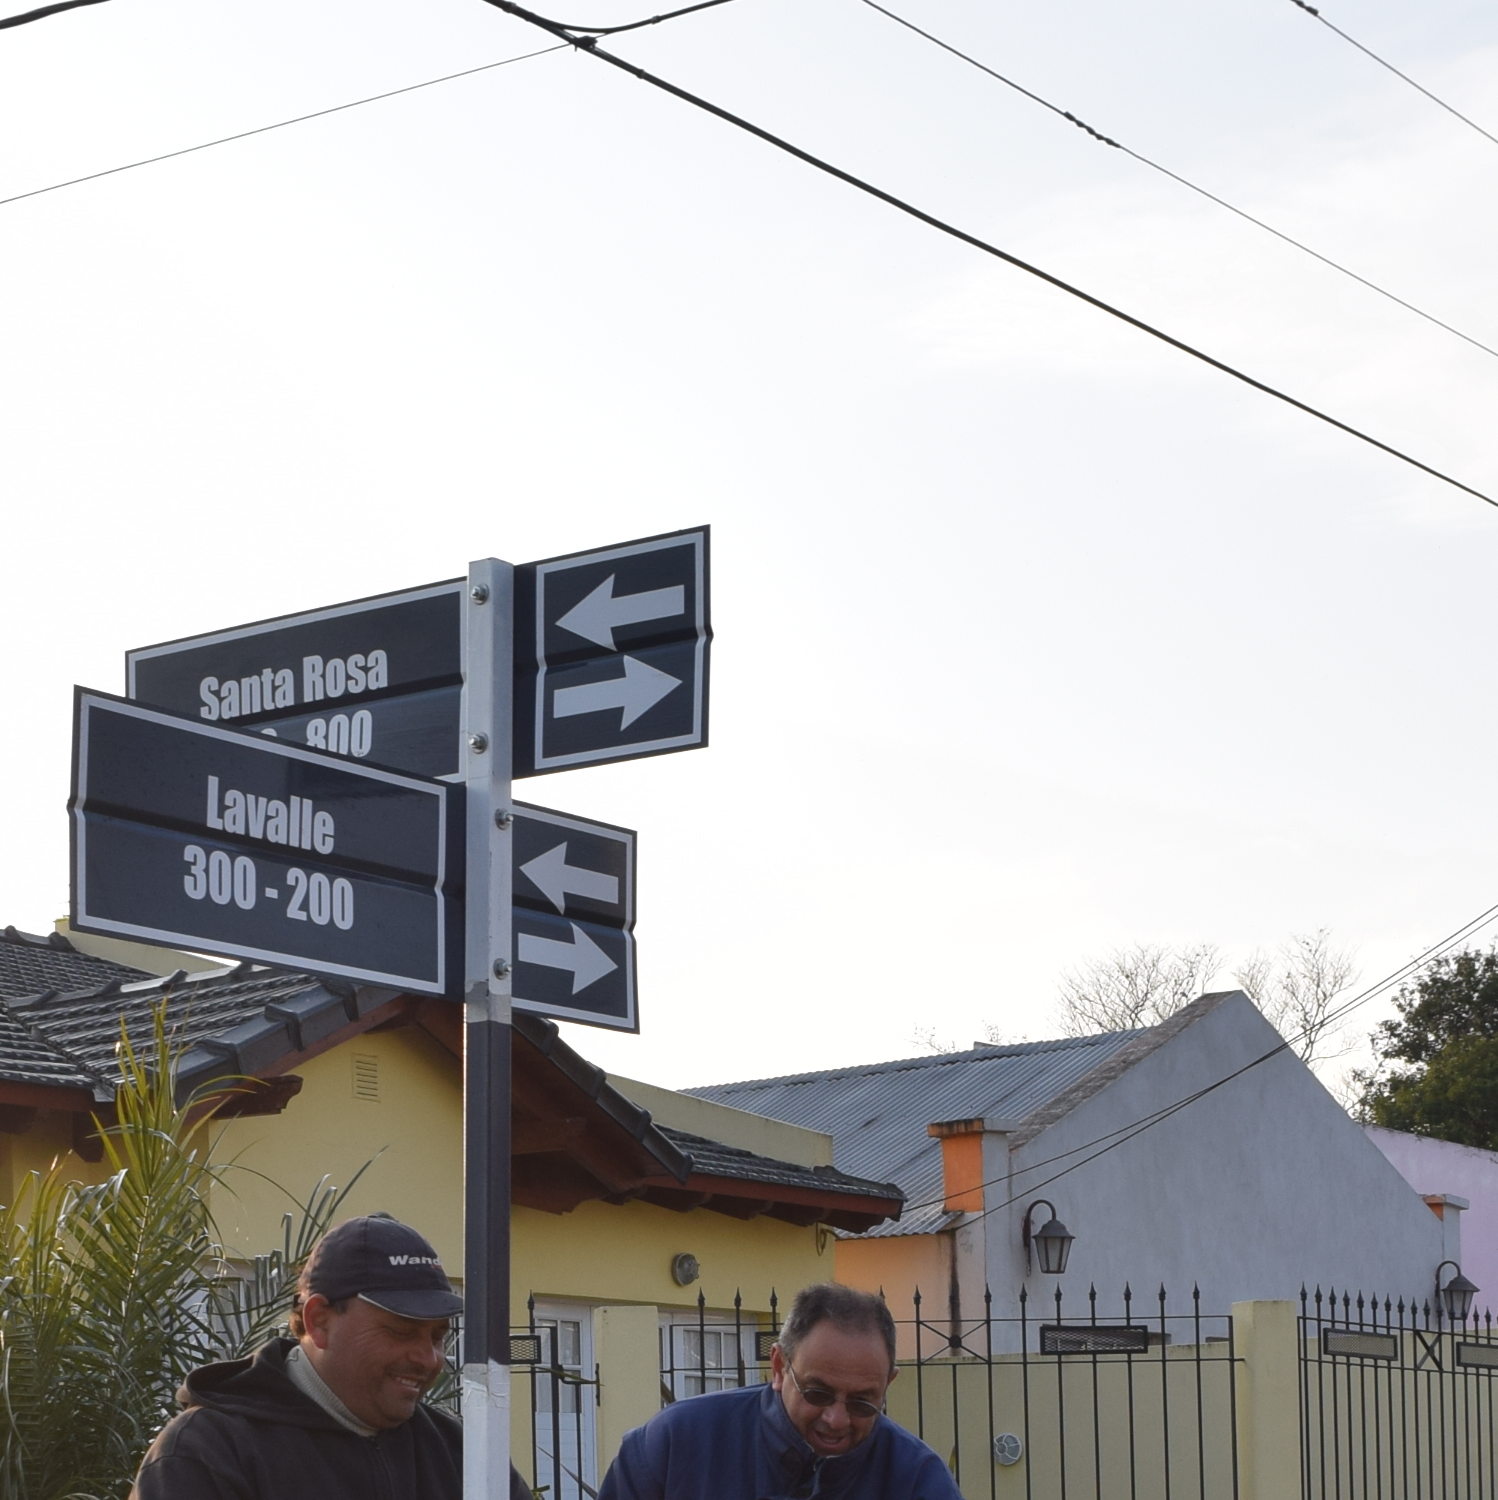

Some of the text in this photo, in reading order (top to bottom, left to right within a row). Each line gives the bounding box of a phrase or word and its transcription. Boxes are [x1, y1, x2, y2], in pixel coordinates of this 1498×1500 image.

[199, 649, 389, 721] Santa Rosa
[306, 709, 373, 758] 800
[206, 775, 335, 855] Lavalle
[183, 844, 354, 930] 300 - 200
